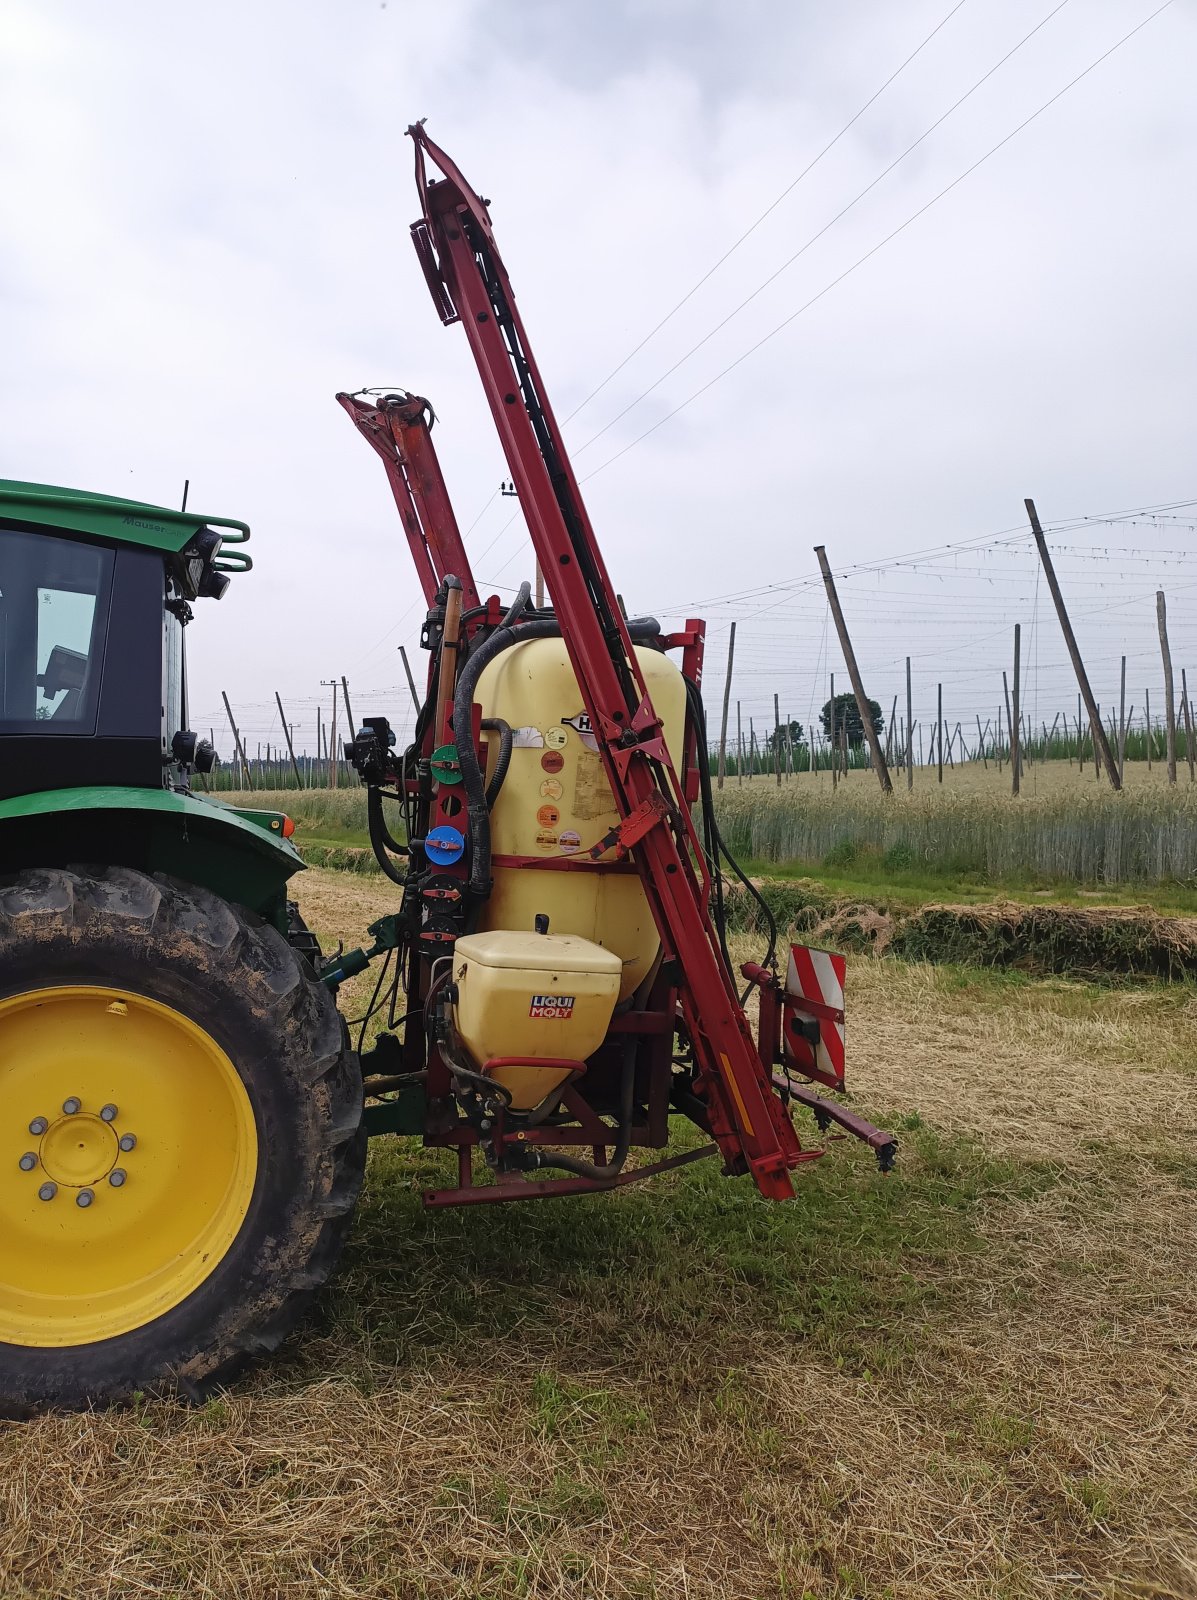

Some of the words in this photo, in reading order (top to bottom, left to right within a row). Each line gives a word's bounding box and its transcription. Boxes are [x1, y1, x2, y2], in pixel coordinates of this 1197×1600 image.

[122, 516, 167, 533] Mauser
[579, 716, 592, 730] H
[533, 996, 573, 1008] LIQUI
[531, 1007, 572, 1018] MOLY
